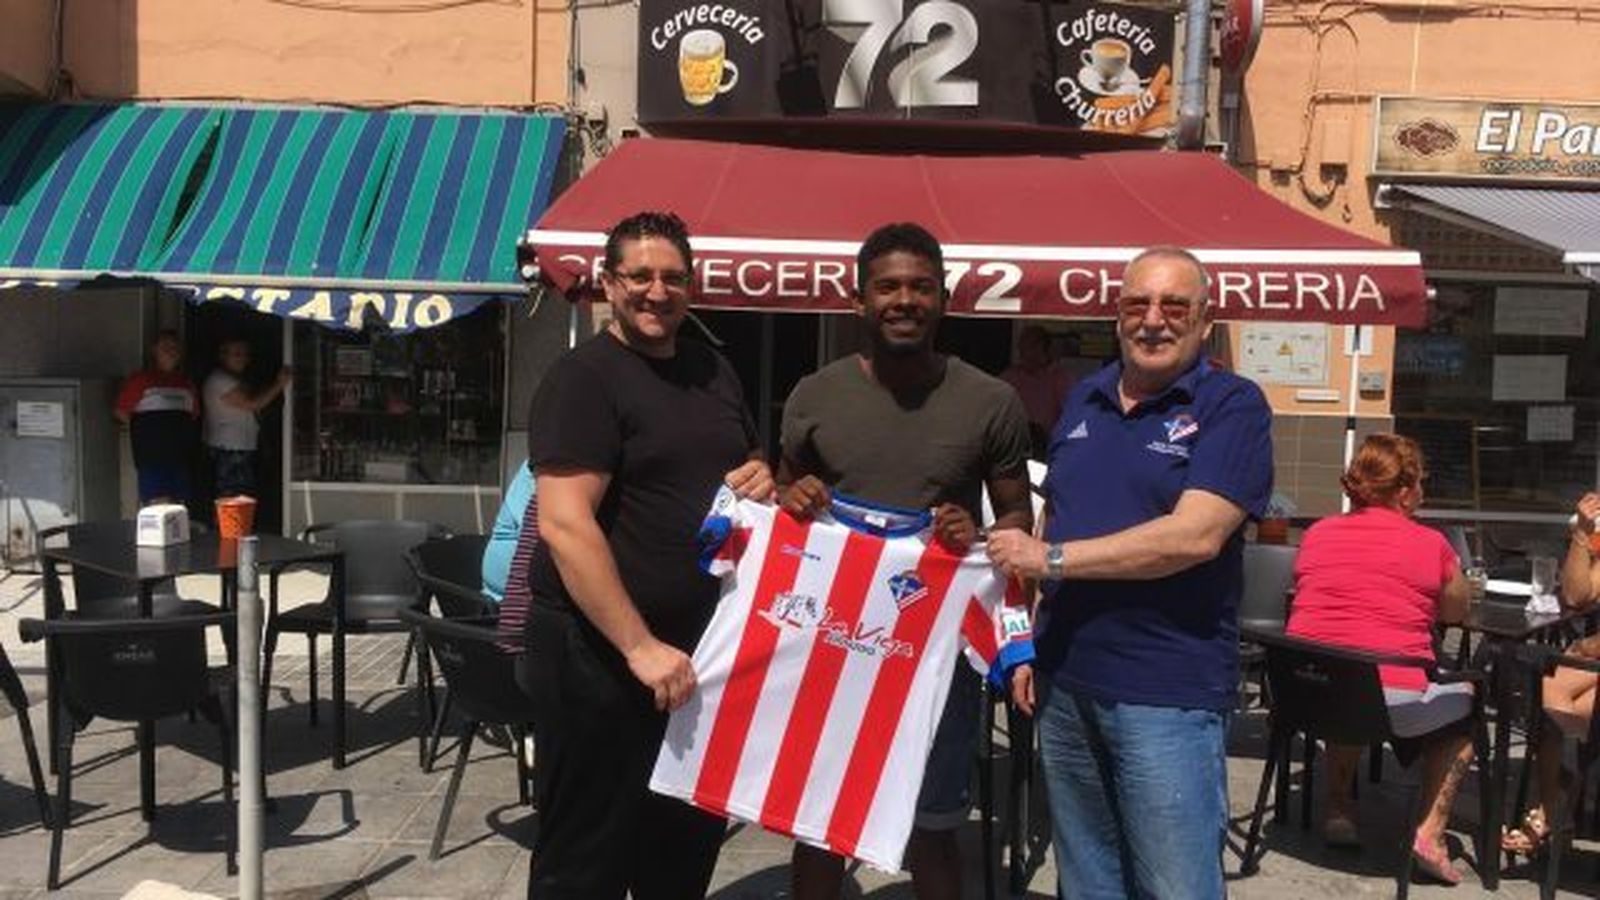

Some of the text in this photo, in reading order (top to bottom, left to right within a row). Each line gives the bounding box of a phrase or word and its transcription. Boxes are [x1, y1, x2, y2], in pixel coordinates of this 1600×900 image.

[651, 4, 765, 50] Cervecería
[822, 0, 979, 108] 72
[1476, 109, 1522, 153] El
[944, 260, 1023, 312] 72
[1059, 267, 1385, 311] CHRERIA
